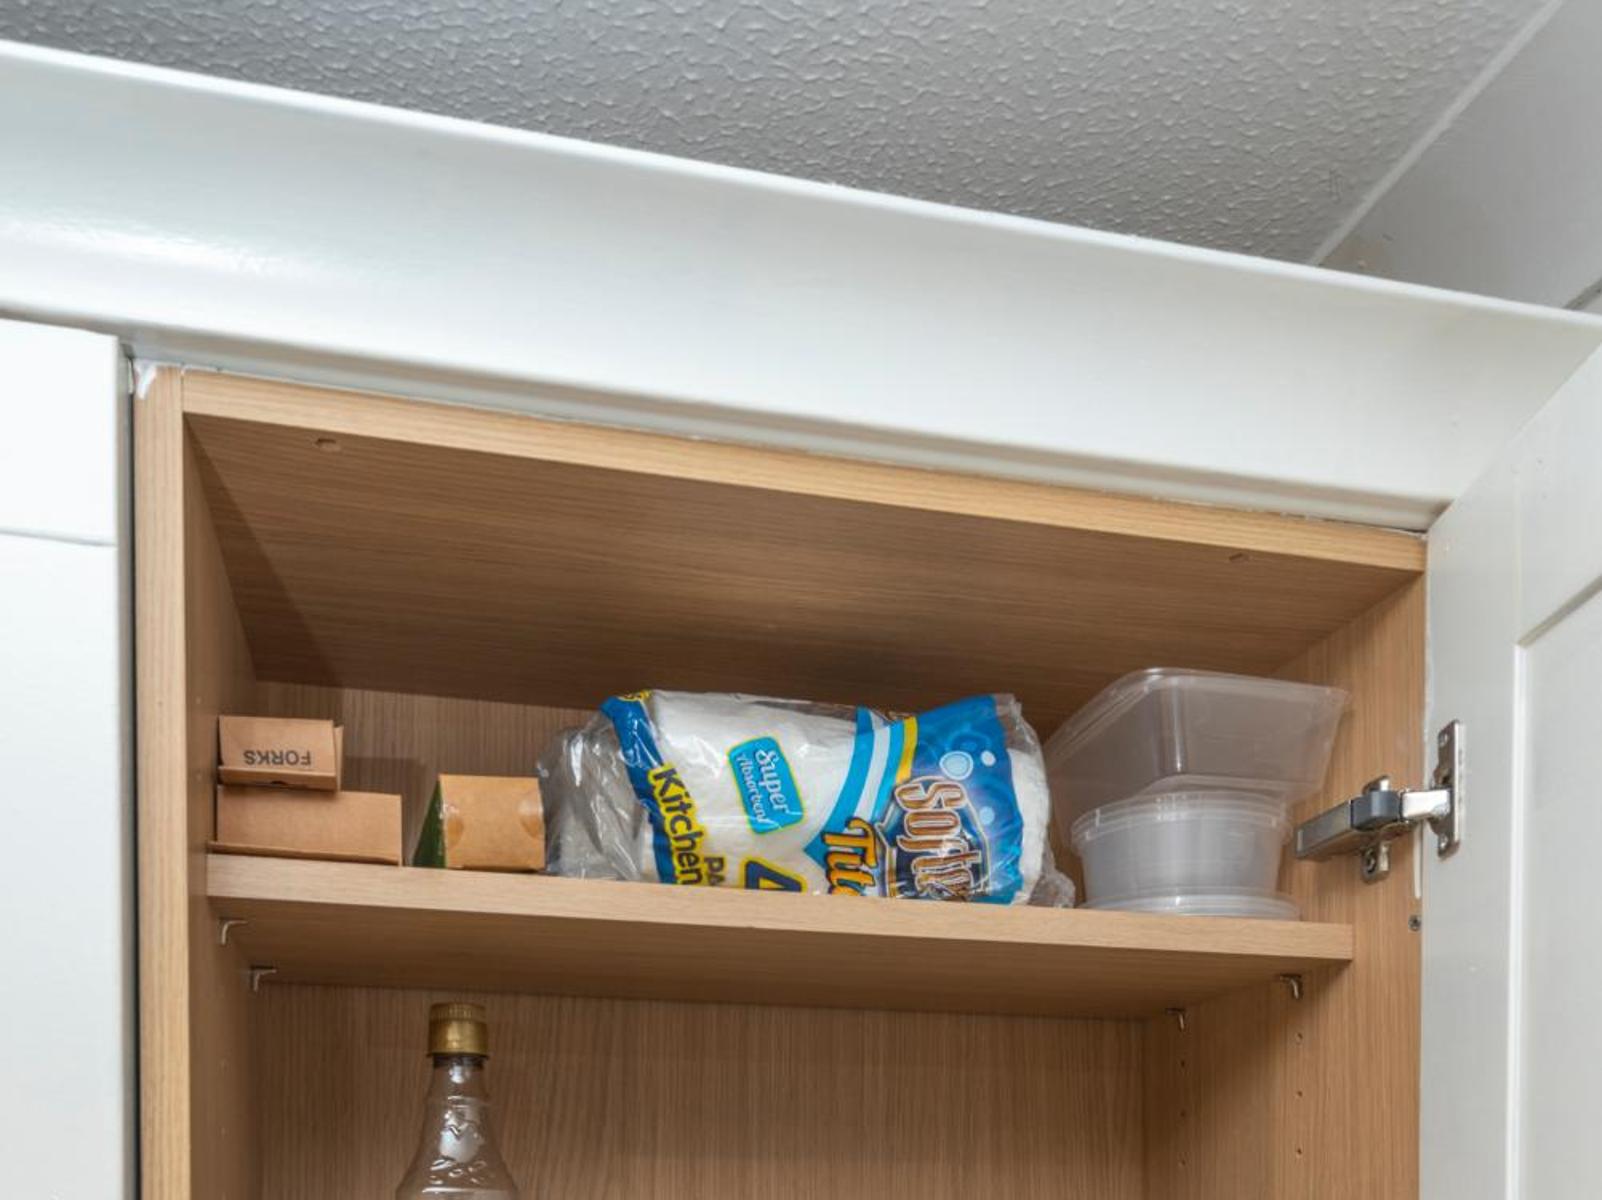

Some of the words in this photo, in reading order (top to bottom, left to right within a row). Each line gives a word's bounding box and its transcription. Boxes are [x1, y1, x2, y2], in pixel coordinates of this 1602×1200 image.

[243, 749, 312, 766] FORKS
[755, 749, 788, 813] Super
[652, 767, 704, 885] Kitchen
